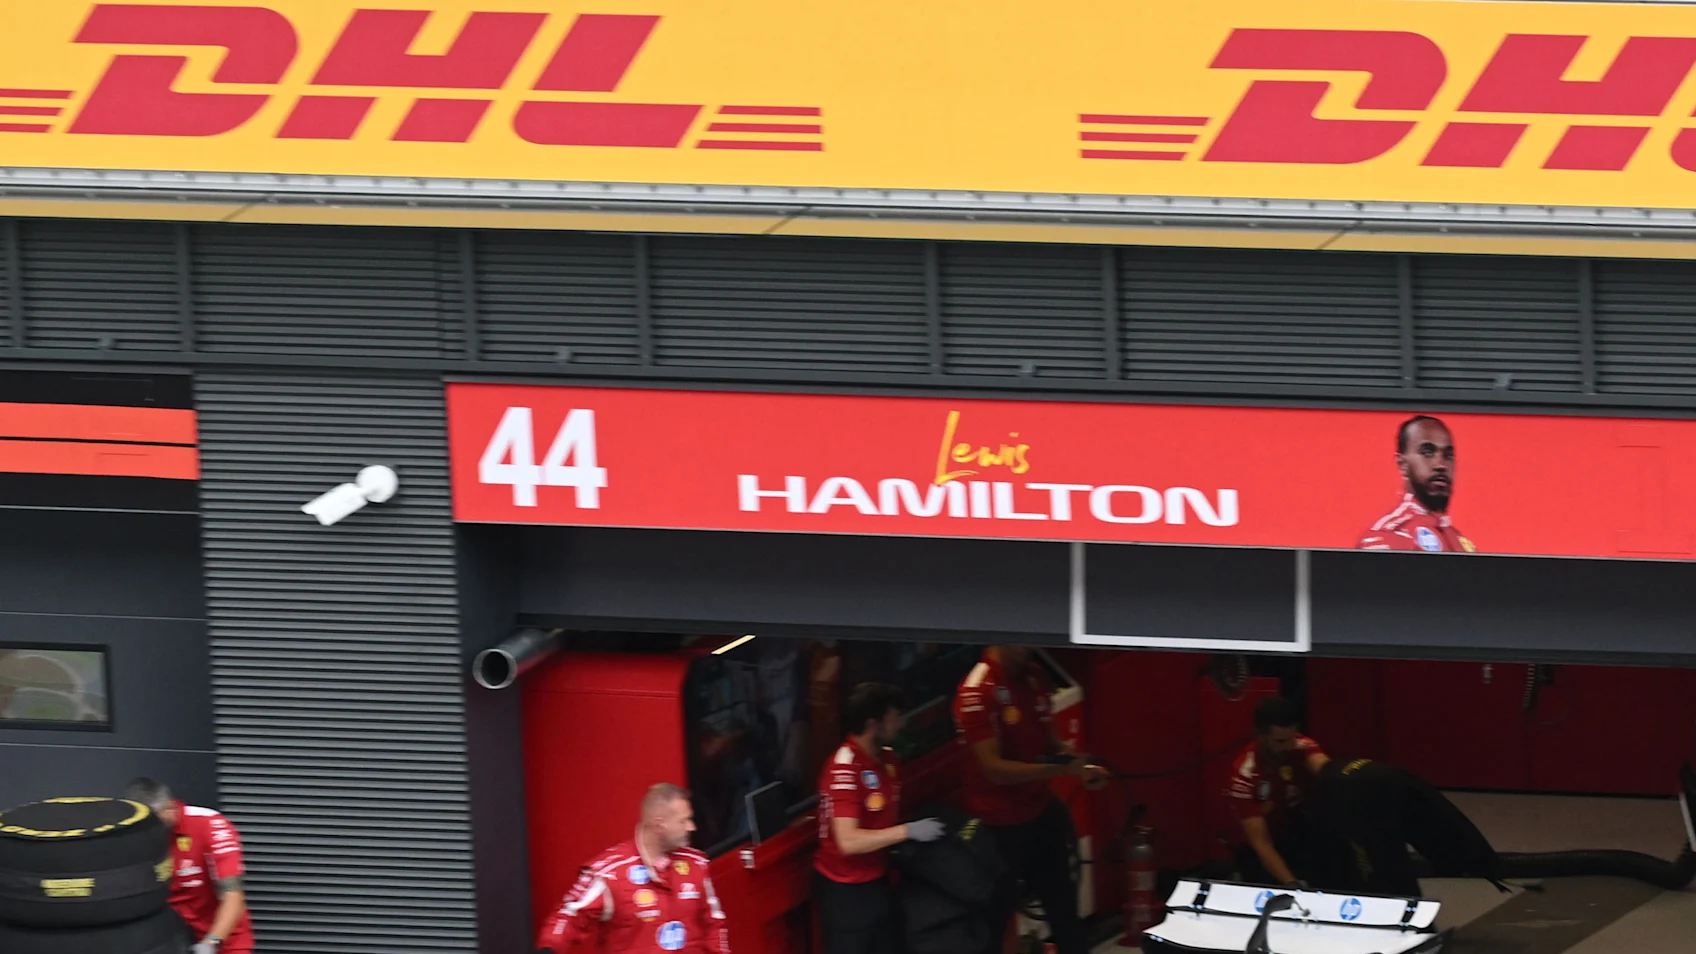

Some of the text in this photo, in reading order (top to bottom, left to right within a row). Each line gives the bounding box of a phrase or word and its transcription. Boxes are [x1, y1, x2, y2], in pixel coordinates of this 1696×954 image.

[67, 3, 705, 148] DHL
[478, 406, 608, 510] 44
[935, 410, 1031, 486] Lewis
[737, 474, 1239, 527] HAMILTON
